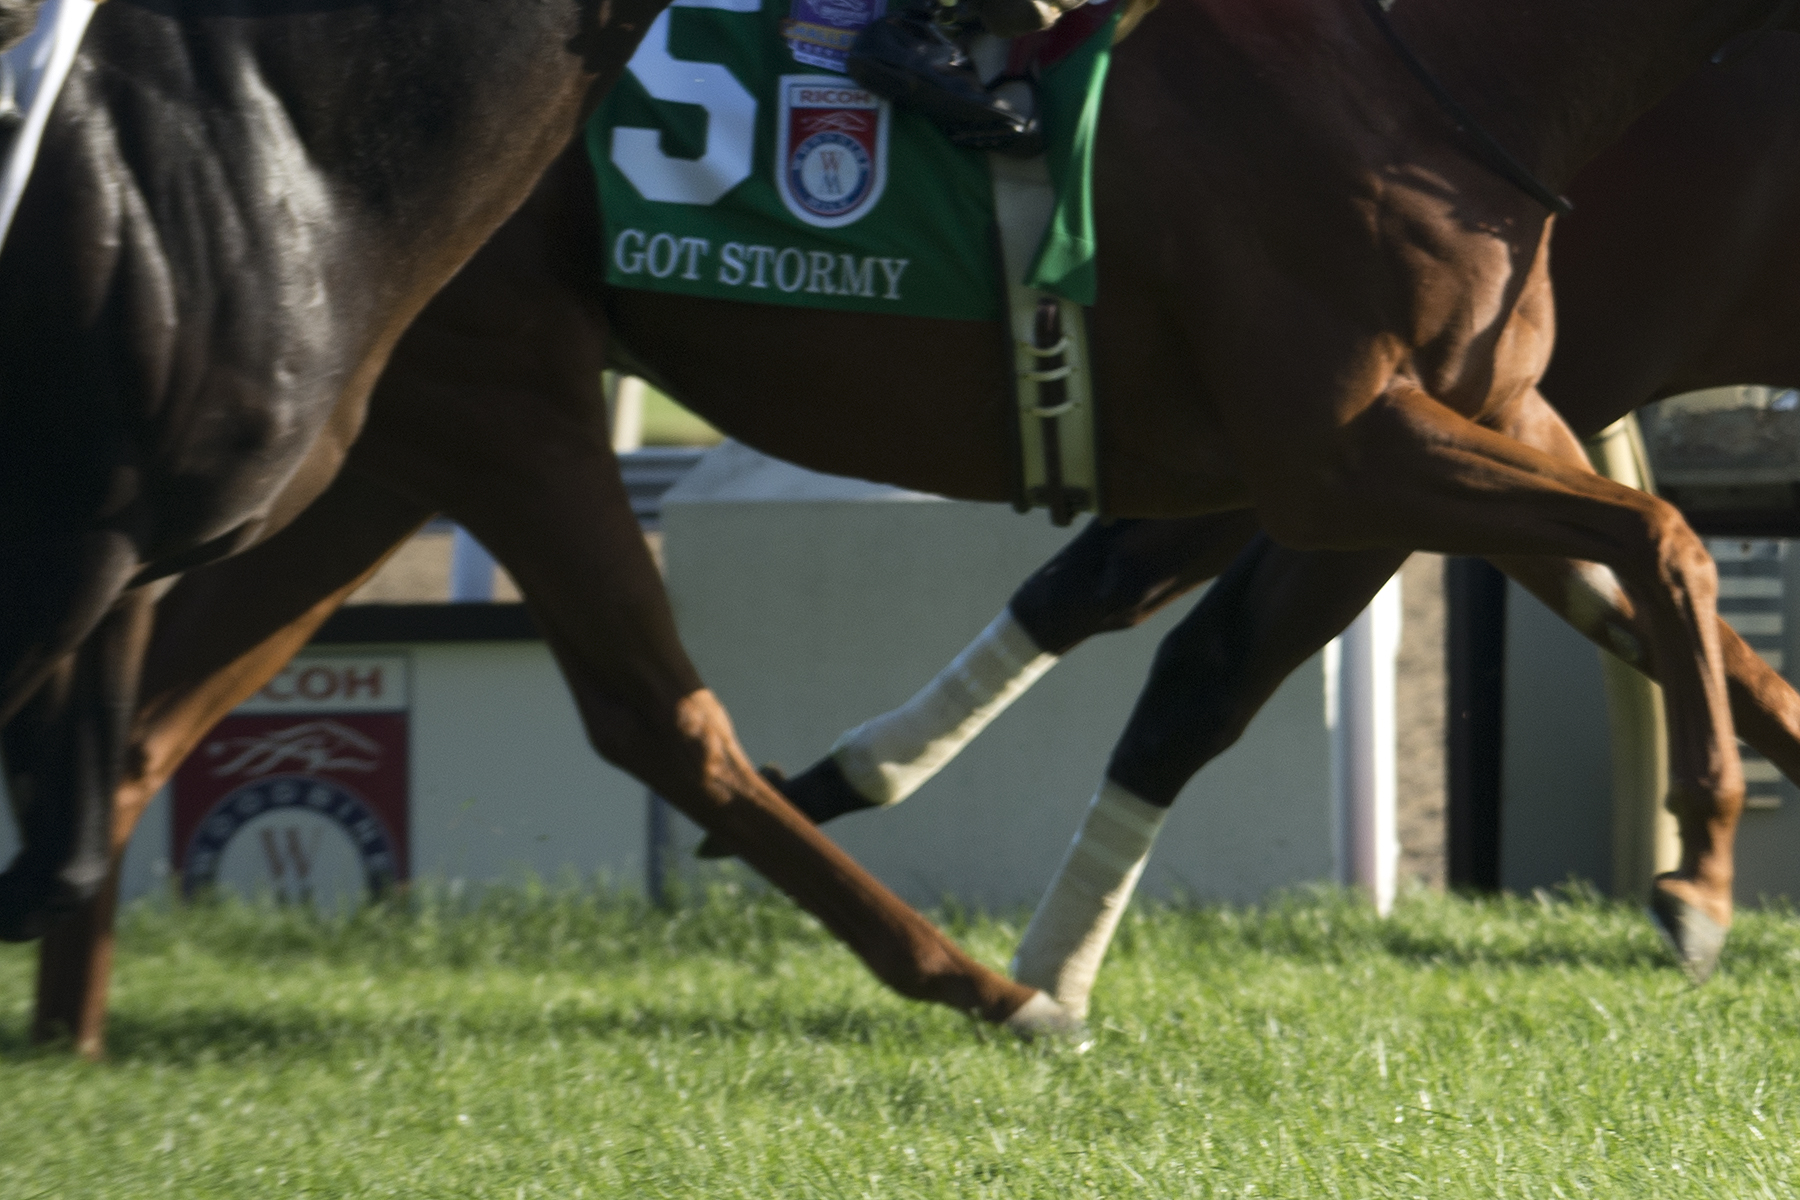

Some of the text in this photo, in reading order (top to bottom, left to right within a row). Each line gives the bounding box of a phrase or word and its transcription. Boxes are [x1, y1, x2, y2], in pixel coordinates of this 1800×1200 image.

[613, 228, 909, 300] GOT STORMY
[260, 666, 383, 701] COH
